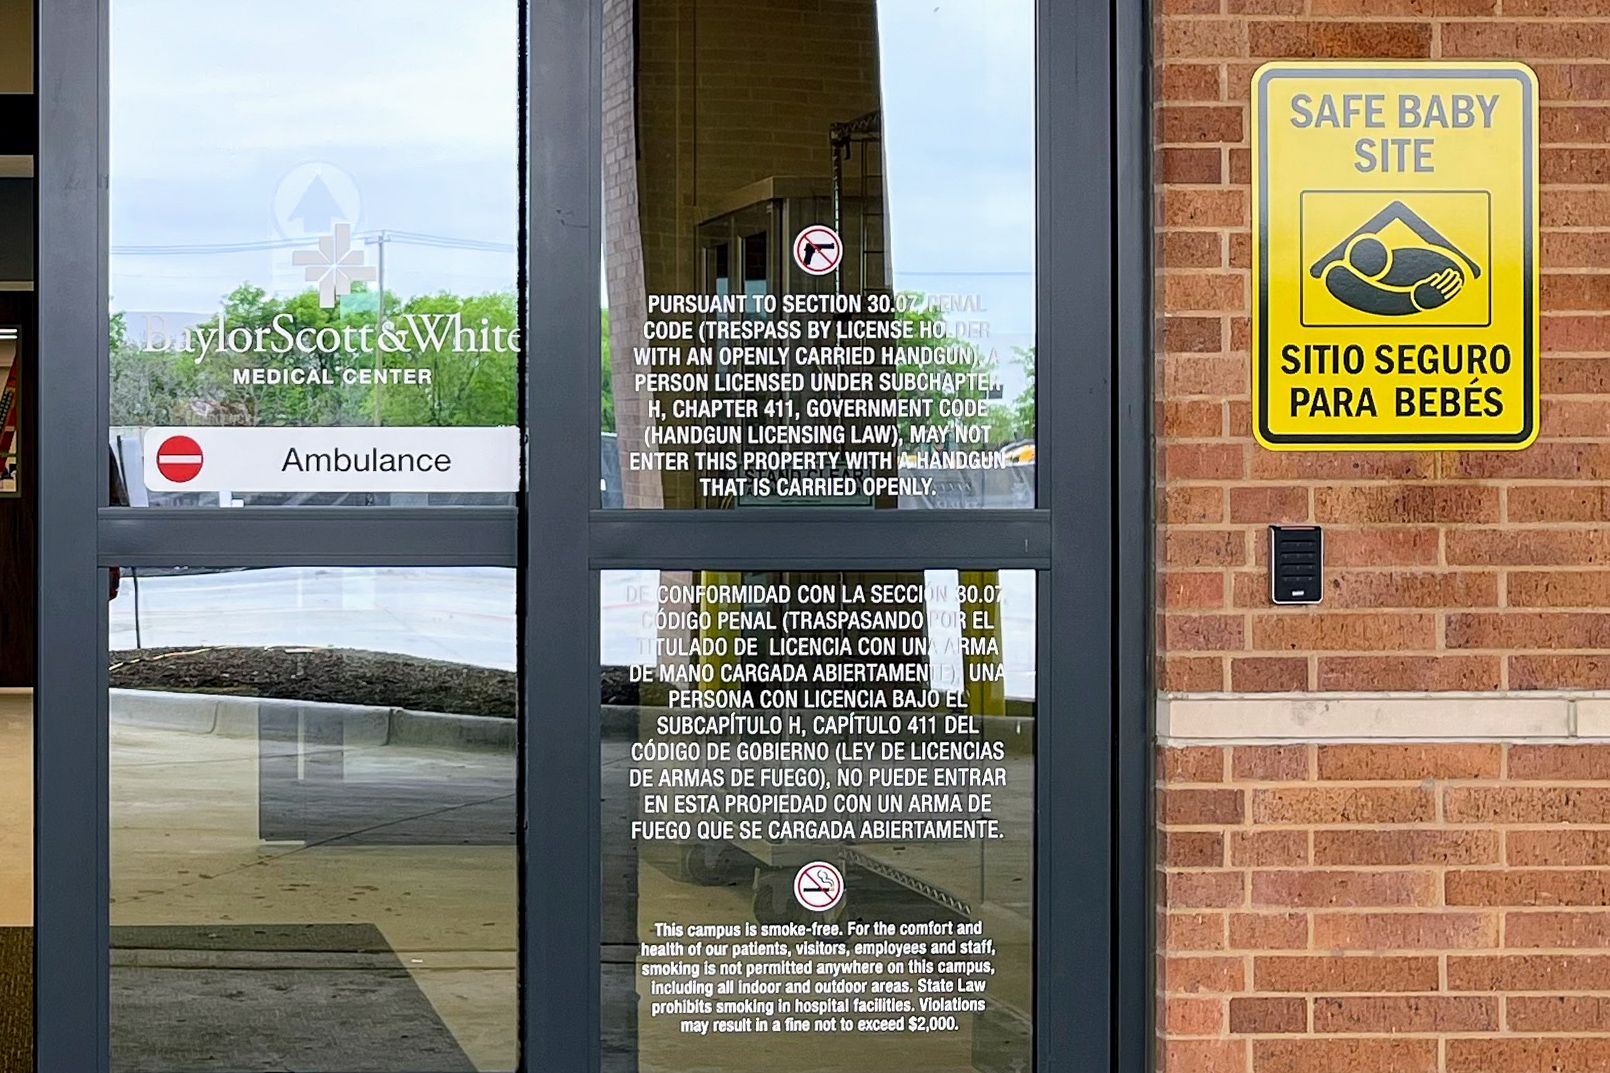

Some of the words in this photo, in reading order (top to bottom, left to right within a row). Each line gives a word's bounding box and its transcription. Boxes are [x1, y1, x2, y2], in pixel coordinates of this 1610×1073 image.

[1290, 94, 1385, 128] SAFE
[1399, 94, 1499, 128] BABY
[1354, 139, 1435, 173] SITE
[649, 295, 746, 313] PURSUANT
[752, 295, 775, 313] TO
[783, 295, 861, 313] SECTION
[644, 321, 692, 339] CODE
[700, 321, 800, 343] (TRESPASS
[808, 321, 830, 339] BY
[838, 321, 913, 339] LICENSE
[920, 321, 990, 339] HOLDER
[634, 347, 681, 366] WITH
[687, 347, 712, 366] AN
[719, 347, 790, 366] OPENLY
[795, 347, 875, 366] CARRIED
[1281, 344, 1364, 375] SITIO
[1374, 344, 1511, 375] SEGURO
[233, 369, 334, 385] MEDICAL
[343, 369, 432, 385] CENTER
[635, 373, 708, 392] PERSON
[715, 373, 805, 392] LICENSED
[810, 373, 874, 392] UNDER
[881, 373, 1001, 392] SUBCHAPTER
[1291, 386, 1377, 417] PARA
[1395, 377, 1504, 417] BEBÉS
[648, 399, 666, 422] H,
[673, 399, 758, 418] CHAPTER
[764, 399, 800, 422] 411,
[807, 399, 934, 418] GOVERNMENT
[939, 399, 988, 418] CODE
[645, 425, 741, 448] (HANDGUN
[748, 425, 845, 444] LICENSING
[851, 425, 902, 448] LAW),
[910, 425, 949, 444] MAY
[954, 425, 991, 444] NOT
[281, 447, 452, 473] Ambulance
[630, 451, 689, 470] ENTER
[694, 451, 736, 470] THIS
[743, 451, 840, 470] PROPERTY
[845, 451, 892, 470] WITH
[897, 451, 911, 470] A
[917, 451, 1007, 470] HANDGUN
[700, 477, 746, 496] THAT
[752, 477, 770, 496] IS
[776, 477, 856, 496] CARRIED
[862, 477, 936, 496] OPENLY.
[658, 585, 791, 604] CONFORMIDAD
[797, 585, 834, 604] CON
[842, 585, 865, 604] LA
[641, 607, 711, 630] CÓDIGO
[717, 611, 776, 630] PENAL
[782, 611, 923, 633] (TRASPASANDO
[928, 611, 966, 630] POR
[973, 611, 994, 630] EL
[638, 637, 728, 656] TITULADO
[734, 637, 757, 656] DE
[770, 637, 852, 656] LICENCIA
[858, 637, 896, 656] CON
[902, 637, 938, 656] UNA
[944, 637, 999, 656] ARMA
[629, 663, 653, 683] DE
[659, 663, 713, 683] MANO
[721, 663, 807, 683] CARGADA
[969, 663, 1005, 683] UNA
[668, 690, 753, 708] PERSONA
[759, 690, 796, 708] CON
[804, 690, 886, 708] LICENCIA
[893, 690, 939, 708] BAJO
[947, 690, 969, 708] EL
[657, 712, 782, 735] SUBCAPÍTULO
[788, 716, 807, 738] H,
[813, 712, 901, 735] CAPÍTULO
[907, 716, 936, 735] 411
[945, 716, 979, 735] DEL
[631, 738, 700, 761] CÓDIGO
[707, 742, 731, 761] DE
[737, 742, 829, 761] GOBIERNO
[835, 742, 875, 764] (LEY
[881, 742, 904, 761] DE
[911, 742, 1005, 761] LICENCIAS
[629, 768, 653, 787] DE
[658, 768, 725, 787] ARMAS
[731, 768, 754, 787] DE
[760, 768, 831, 790] FUEGO),
[838, 768, 863, 787] NO
[869, 768, 928, 787] PUEDE
[934, 768, 1007, 787] ENTRAR
[645, 794, 668, 813] EN
[674, 794, 720, 813] ESTA
[725, 794, 827, 813] PROPIEDAD
[834, 794, 871, 813] CON
[878, 794, 902, 813] UN
[908, 794, 963, 813] ARMA
[968, 794, 992, 813] DE
[631, 820, 691, 839] FUEGO
[697, 820, 733, 839] QUE
[740, 820, 761, 839] SE
[768, 820, 855, 839] CARGADA
[860, 820, 1004, 839] ABIERTAMENTE.
[654, 922, 683, 937] This
[687, 926, 740, 941] campus
[745, 922, 757, 937] is
[761, 922, 843, 937] smoke-free.
[848, 922, 869, 937] For
[874, 922, 895, 937] the
[900, 921, 952, 936] comfort
[957, 921, 982, 936] and
[641, 941, 683, 956] health
[688, 941, 701, 956] of
[706, 945, 728, 956] our
[732, 941, 792, 959] patients,
[796, 941, 850, 958] visitors,
[854, 941, 926, 959] employees
[931, 941, 956, 955] and
[960, 941, 995, 958] staff,
[642, 960, 700, 978] smoking
[704, 960, 716, 976] is
[720, 960, 741, 976] not
[747, 960, 812, 978] permitted
[817, 960, 882, 978] anywhere
[888, 963, 903, 976] on
[908, 960, 933, 976] this
[938, 963, 994, 978] campus,
[652, 980, 713, 997] including
[718, 980, 734, 994] all
[739, 980, 781, 994] indoor
[786, 980, 810, 994] and
[815, 980, 868, 994] outdoor
[872, 983, 912, 994] areas.
[918, 979, 953, 994] State
[958, 979, 986, 994] Law
[652, 999, 712, 1017] prohibits
[716, 999, 774, 1017] smoking
[779, 999, 790, 1014] in
[795, 999, 849, 1016] hospital
[854, 999, 915, 1014] facilities.
[920, 999, 986, 1014] Violations
[681, 1022, 708, 1036] may
[713, 1018, 751, 1032] result
[756, 1018, 768, 1032] in
[772, 1022, 781, 1032] a
[785, 1018, 809, 1032] fine
[814, 1018, 836, 1032] not
[841, 1018, 853, 1032] to
[858, 1018, 904, 1032] exceed
[908, 1016, 958, 1033] $2,000.
